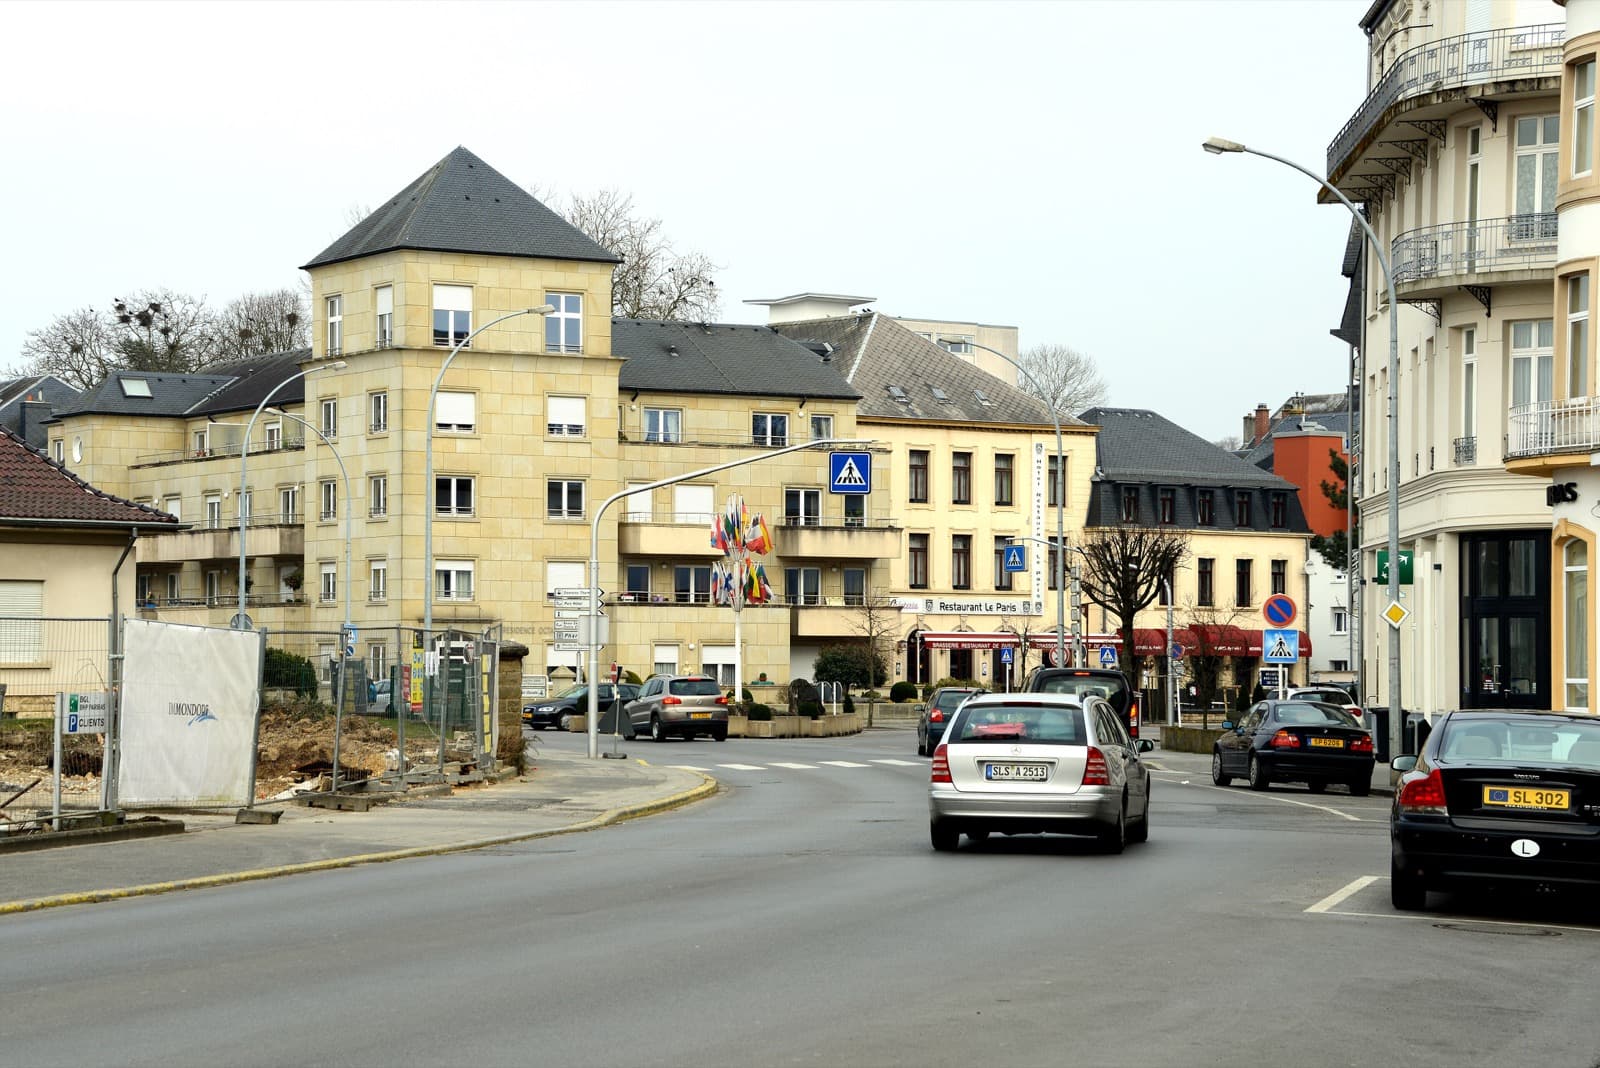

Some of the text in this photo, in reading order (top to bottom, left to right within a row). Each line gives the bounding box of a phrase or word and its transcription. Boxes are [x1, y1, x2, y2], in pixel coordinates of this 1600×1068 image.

[939, 601, 1017, 612] Restaurant Le Paris
[79, 718, 105, 728] CLIENTS
[992, 766, 1045, 777] SLS A 2513
[1513, 790, 1564, 806] SL 302
[1522, 840, 1531, 855] L
